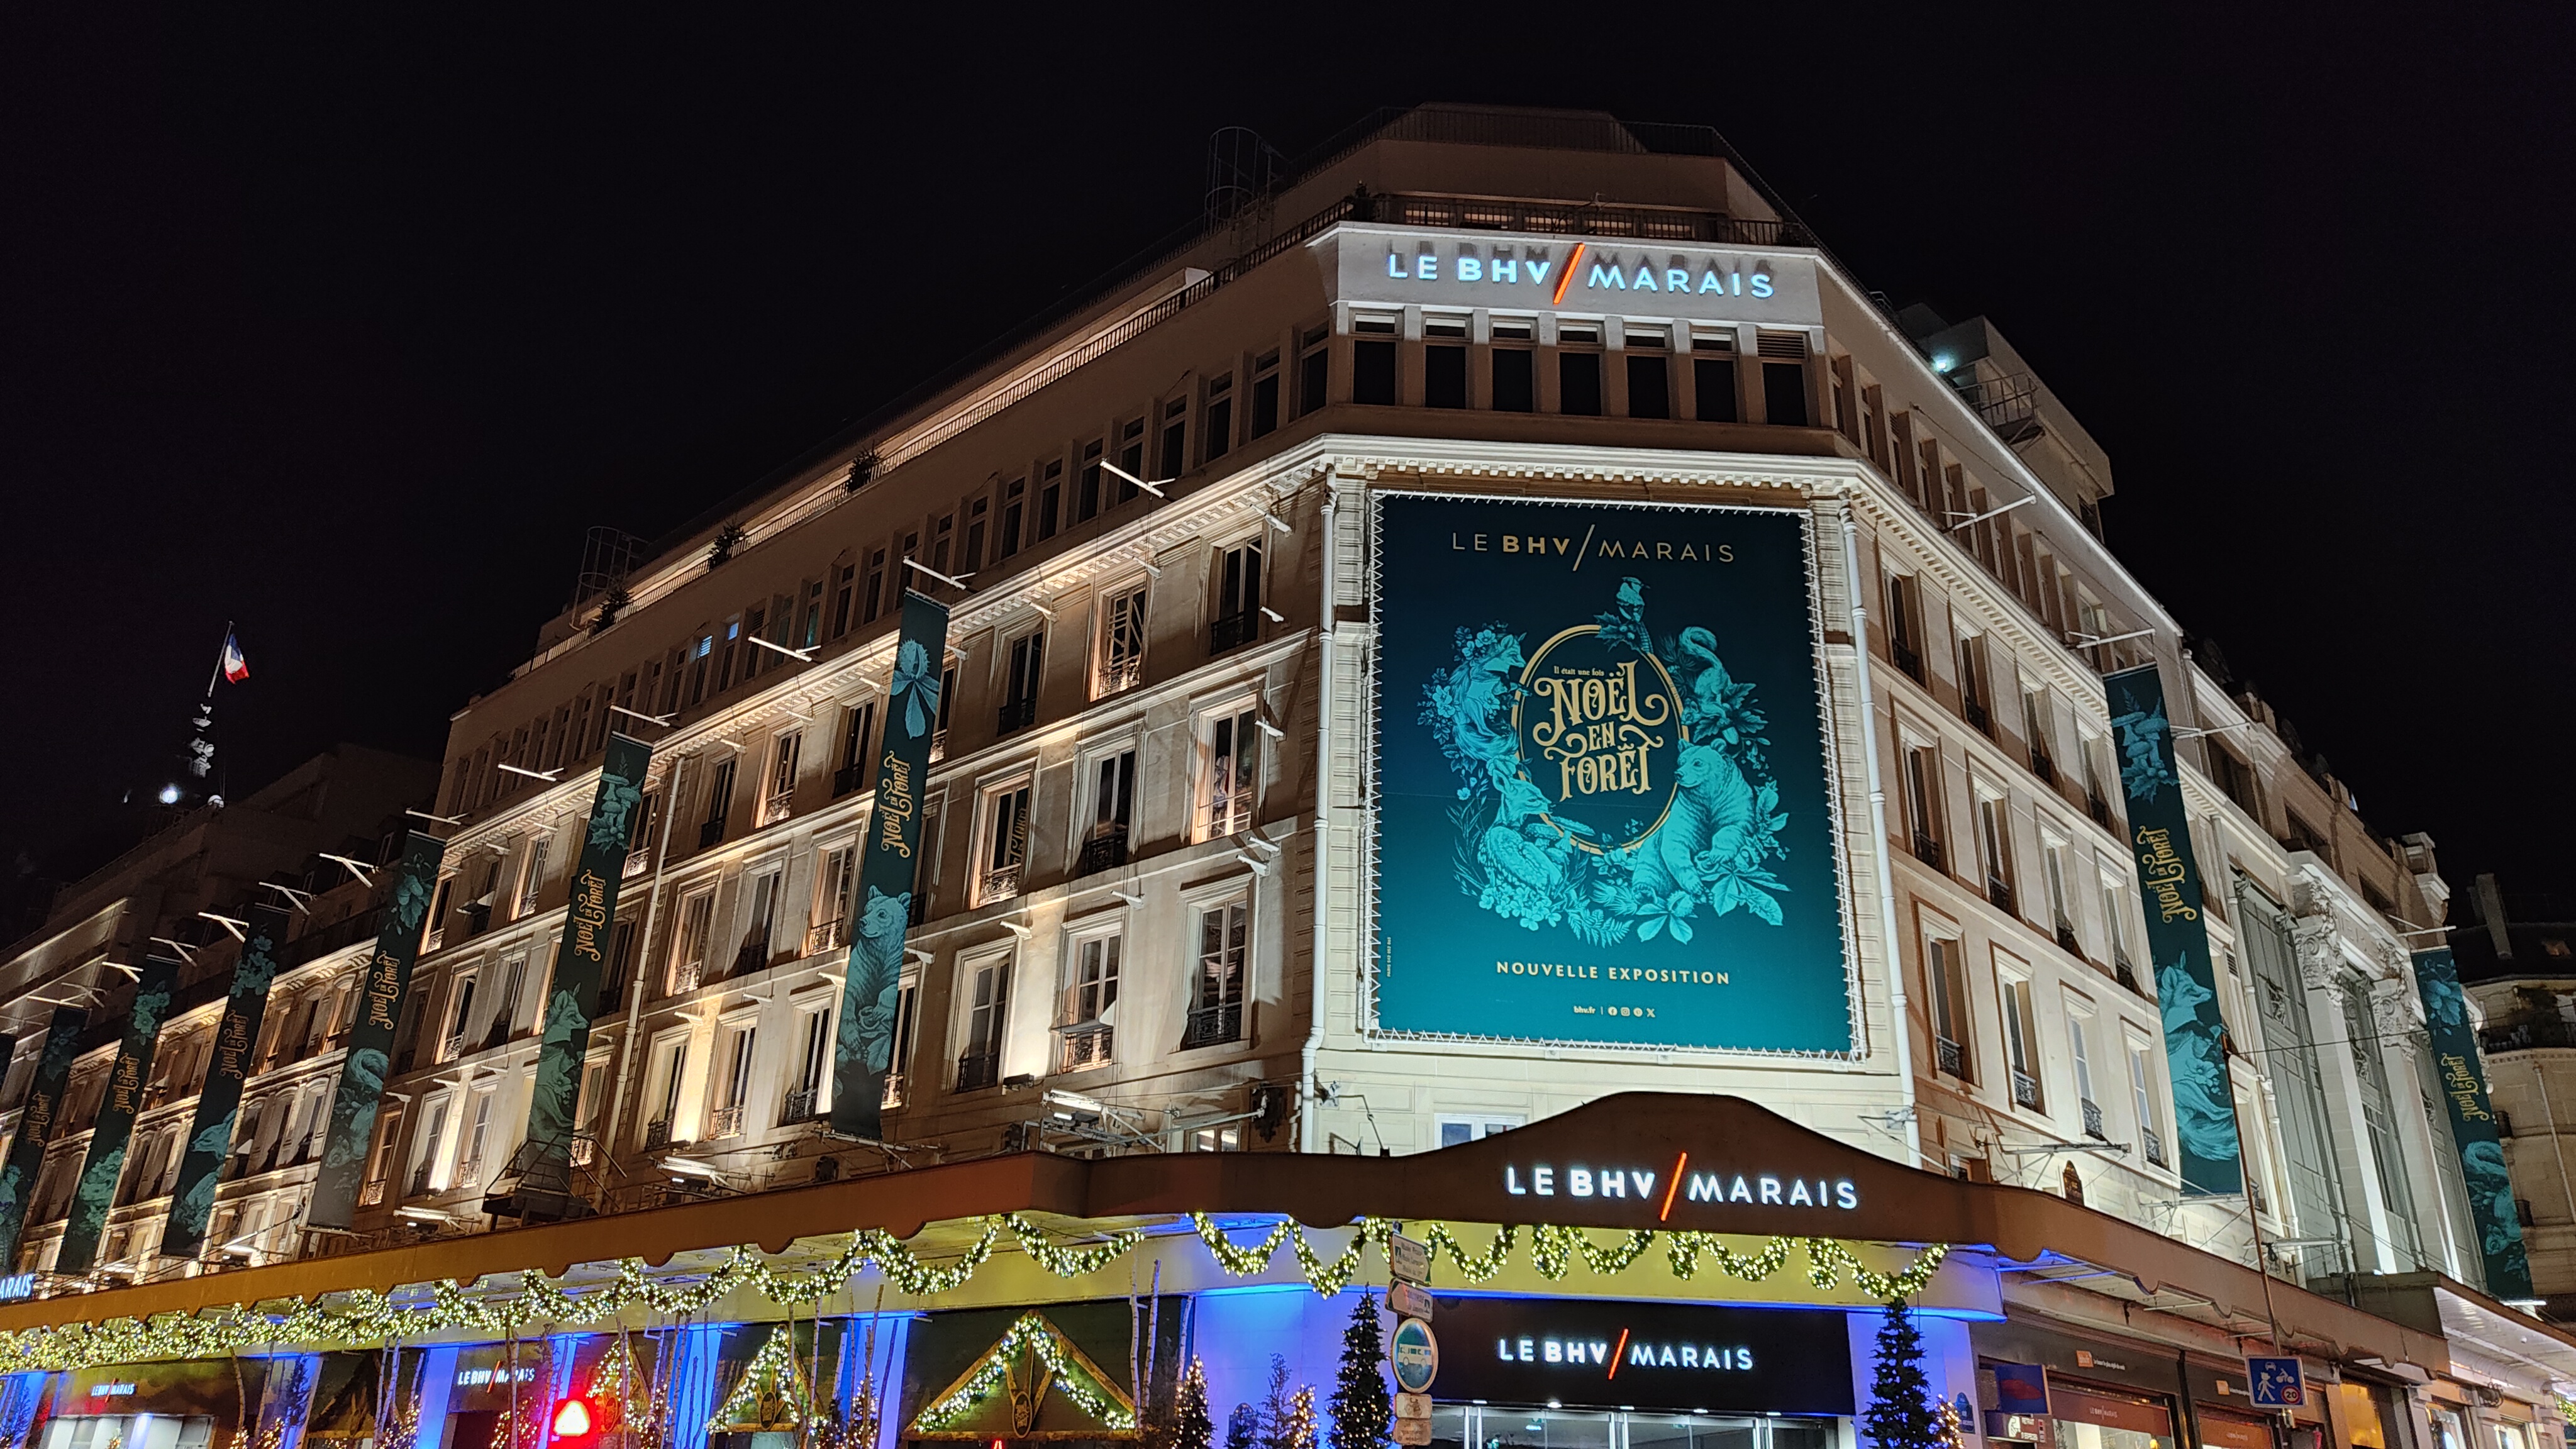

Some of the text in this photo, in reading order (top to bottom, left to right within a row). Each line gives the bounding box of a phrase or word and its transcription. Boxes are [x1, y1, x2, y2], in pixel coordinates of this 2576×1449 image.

[1389, 254, 1437, 280] LE
[1453, 532, 1488, 551] LE
[1553, 665, 1560, 674] Il
[1592, 668, 1604, 677] fois
[1533, 659, 1669, 747] NOËL
[1497, 961, 1730, 985] NOUVELLE EXPOSITION
[1507, 1167, 1554, 1196] LE
[1498, 1339, 1534, 1361] LE
[458, 1371, 470, 1385] LE
